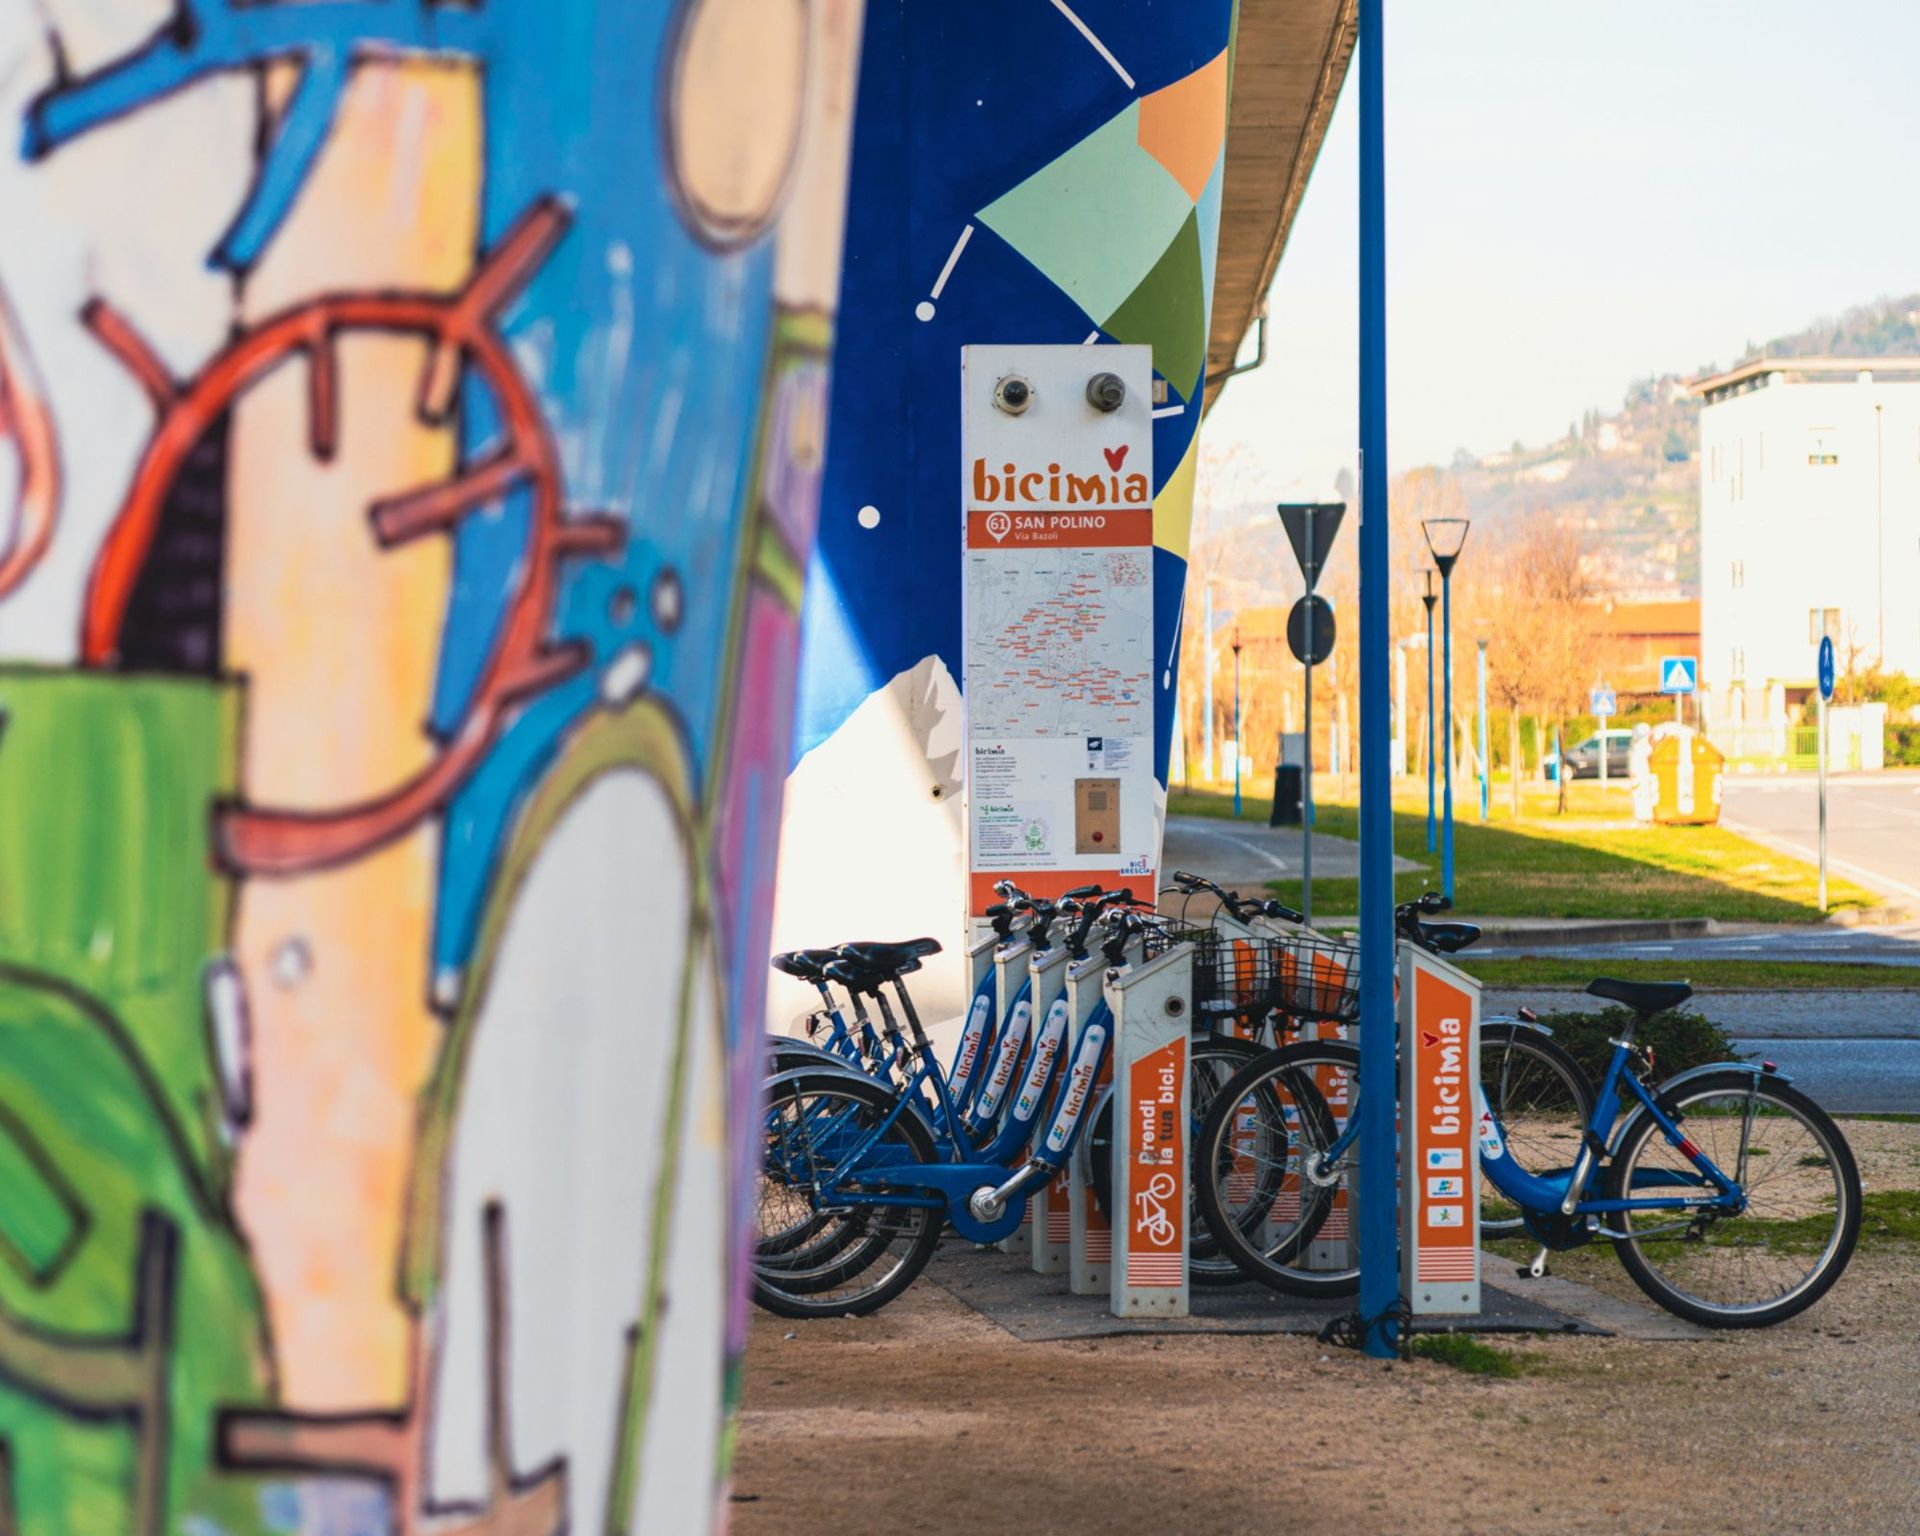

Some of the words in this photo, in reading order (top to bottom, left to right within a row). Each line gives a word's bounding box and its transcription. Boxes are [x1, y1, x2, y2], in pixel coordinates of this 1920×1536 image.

[973, 445, 1147, 505] bicimia
[990, 517, 1006, 531] 61
[1015, 516, 1045, 529] SAN
[1051, 516, 1106, 529] POLINO
[1015, 531, 1030, 541] Via
[1032, 531, 1058, 541] Bazoli
[957, 1031, 982, 1079] bicimia
[994, 1037, 1020, 1087] bicimia
[1030, 1038, 1058, 1088] bicimia
[1423, 1018, 1461, 1135] bicimia
[1065, 1064, 1093, 1117] bicimia
[1158, 1062, 1175, 1104] bici.
[1138, 1099, 1156, 1164] Prendi
[1159, 1109, 1174, 1141] tua
[1158, 1146, 1174, 1165] la
